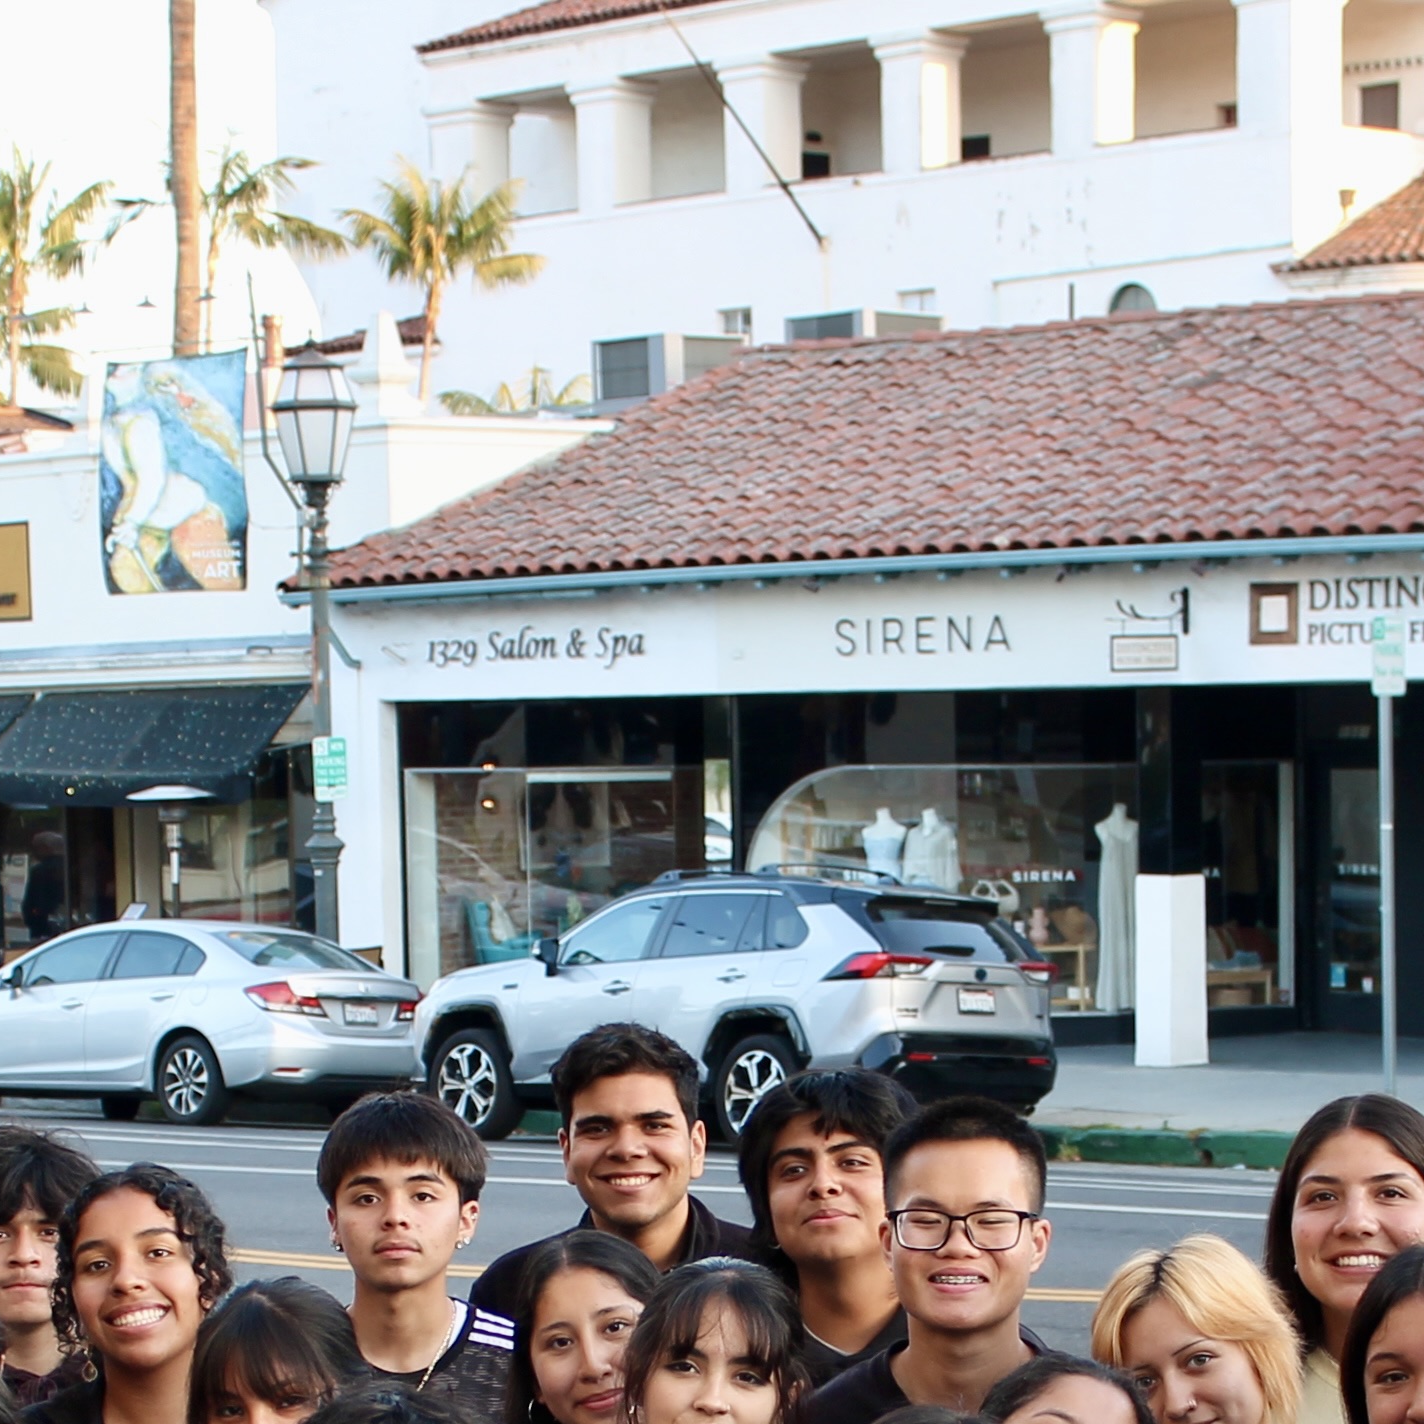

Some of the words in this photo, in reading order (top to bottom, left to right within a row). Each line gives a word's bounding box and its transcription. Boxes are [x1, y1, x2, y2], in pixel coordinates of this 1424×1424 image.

[203, 560, 241, 578] ART
[835, 614, 1012, 657] SIRENA
[427, 639, 478, 668] 1329
[485, 625, 557, 662] Salon
[566, 627, 586, 659] &
[594, 626, 645, 670] Spa
[1012, 870, 1076, 883] SIRENA
[1338, 864, 1381, 876] SIREN
